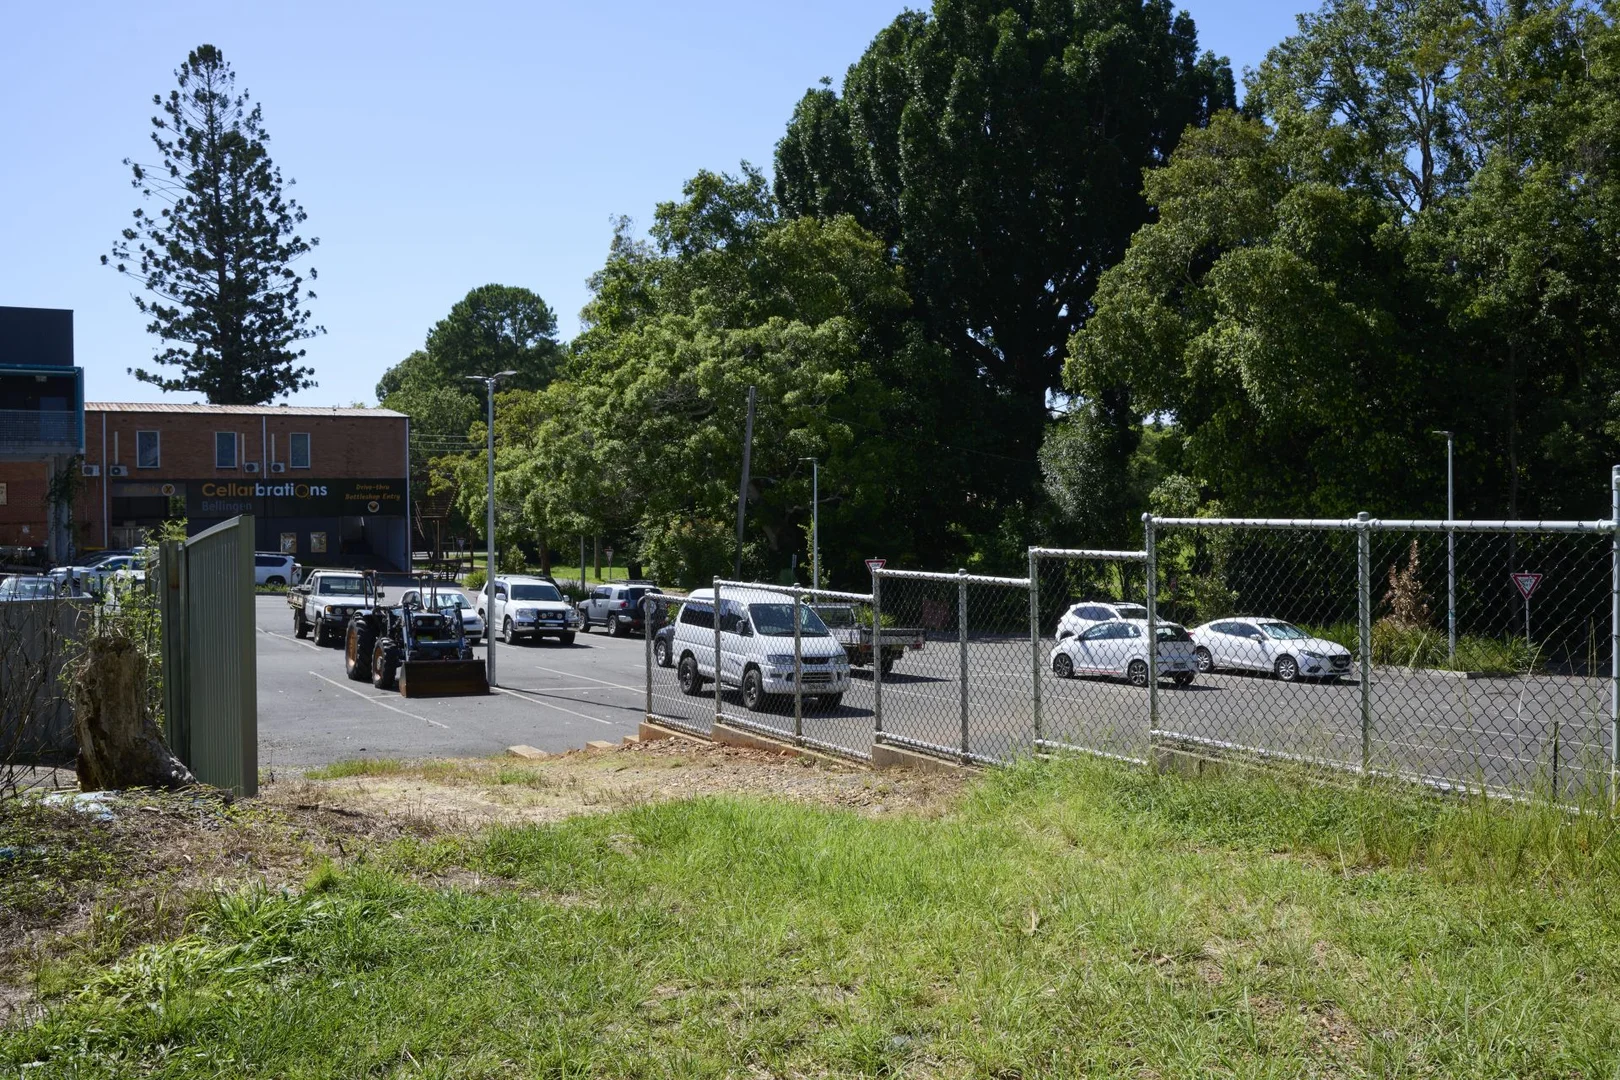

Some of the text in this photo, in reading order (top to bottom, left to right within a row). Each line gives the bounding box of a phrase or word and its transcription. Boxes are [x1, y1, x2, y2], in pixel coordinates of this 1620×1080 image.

[202, 483, 328, 498] Cellarbrations
[383, 493, 401, 501] Entry
[202, 500, 252, 513] Bellingen
